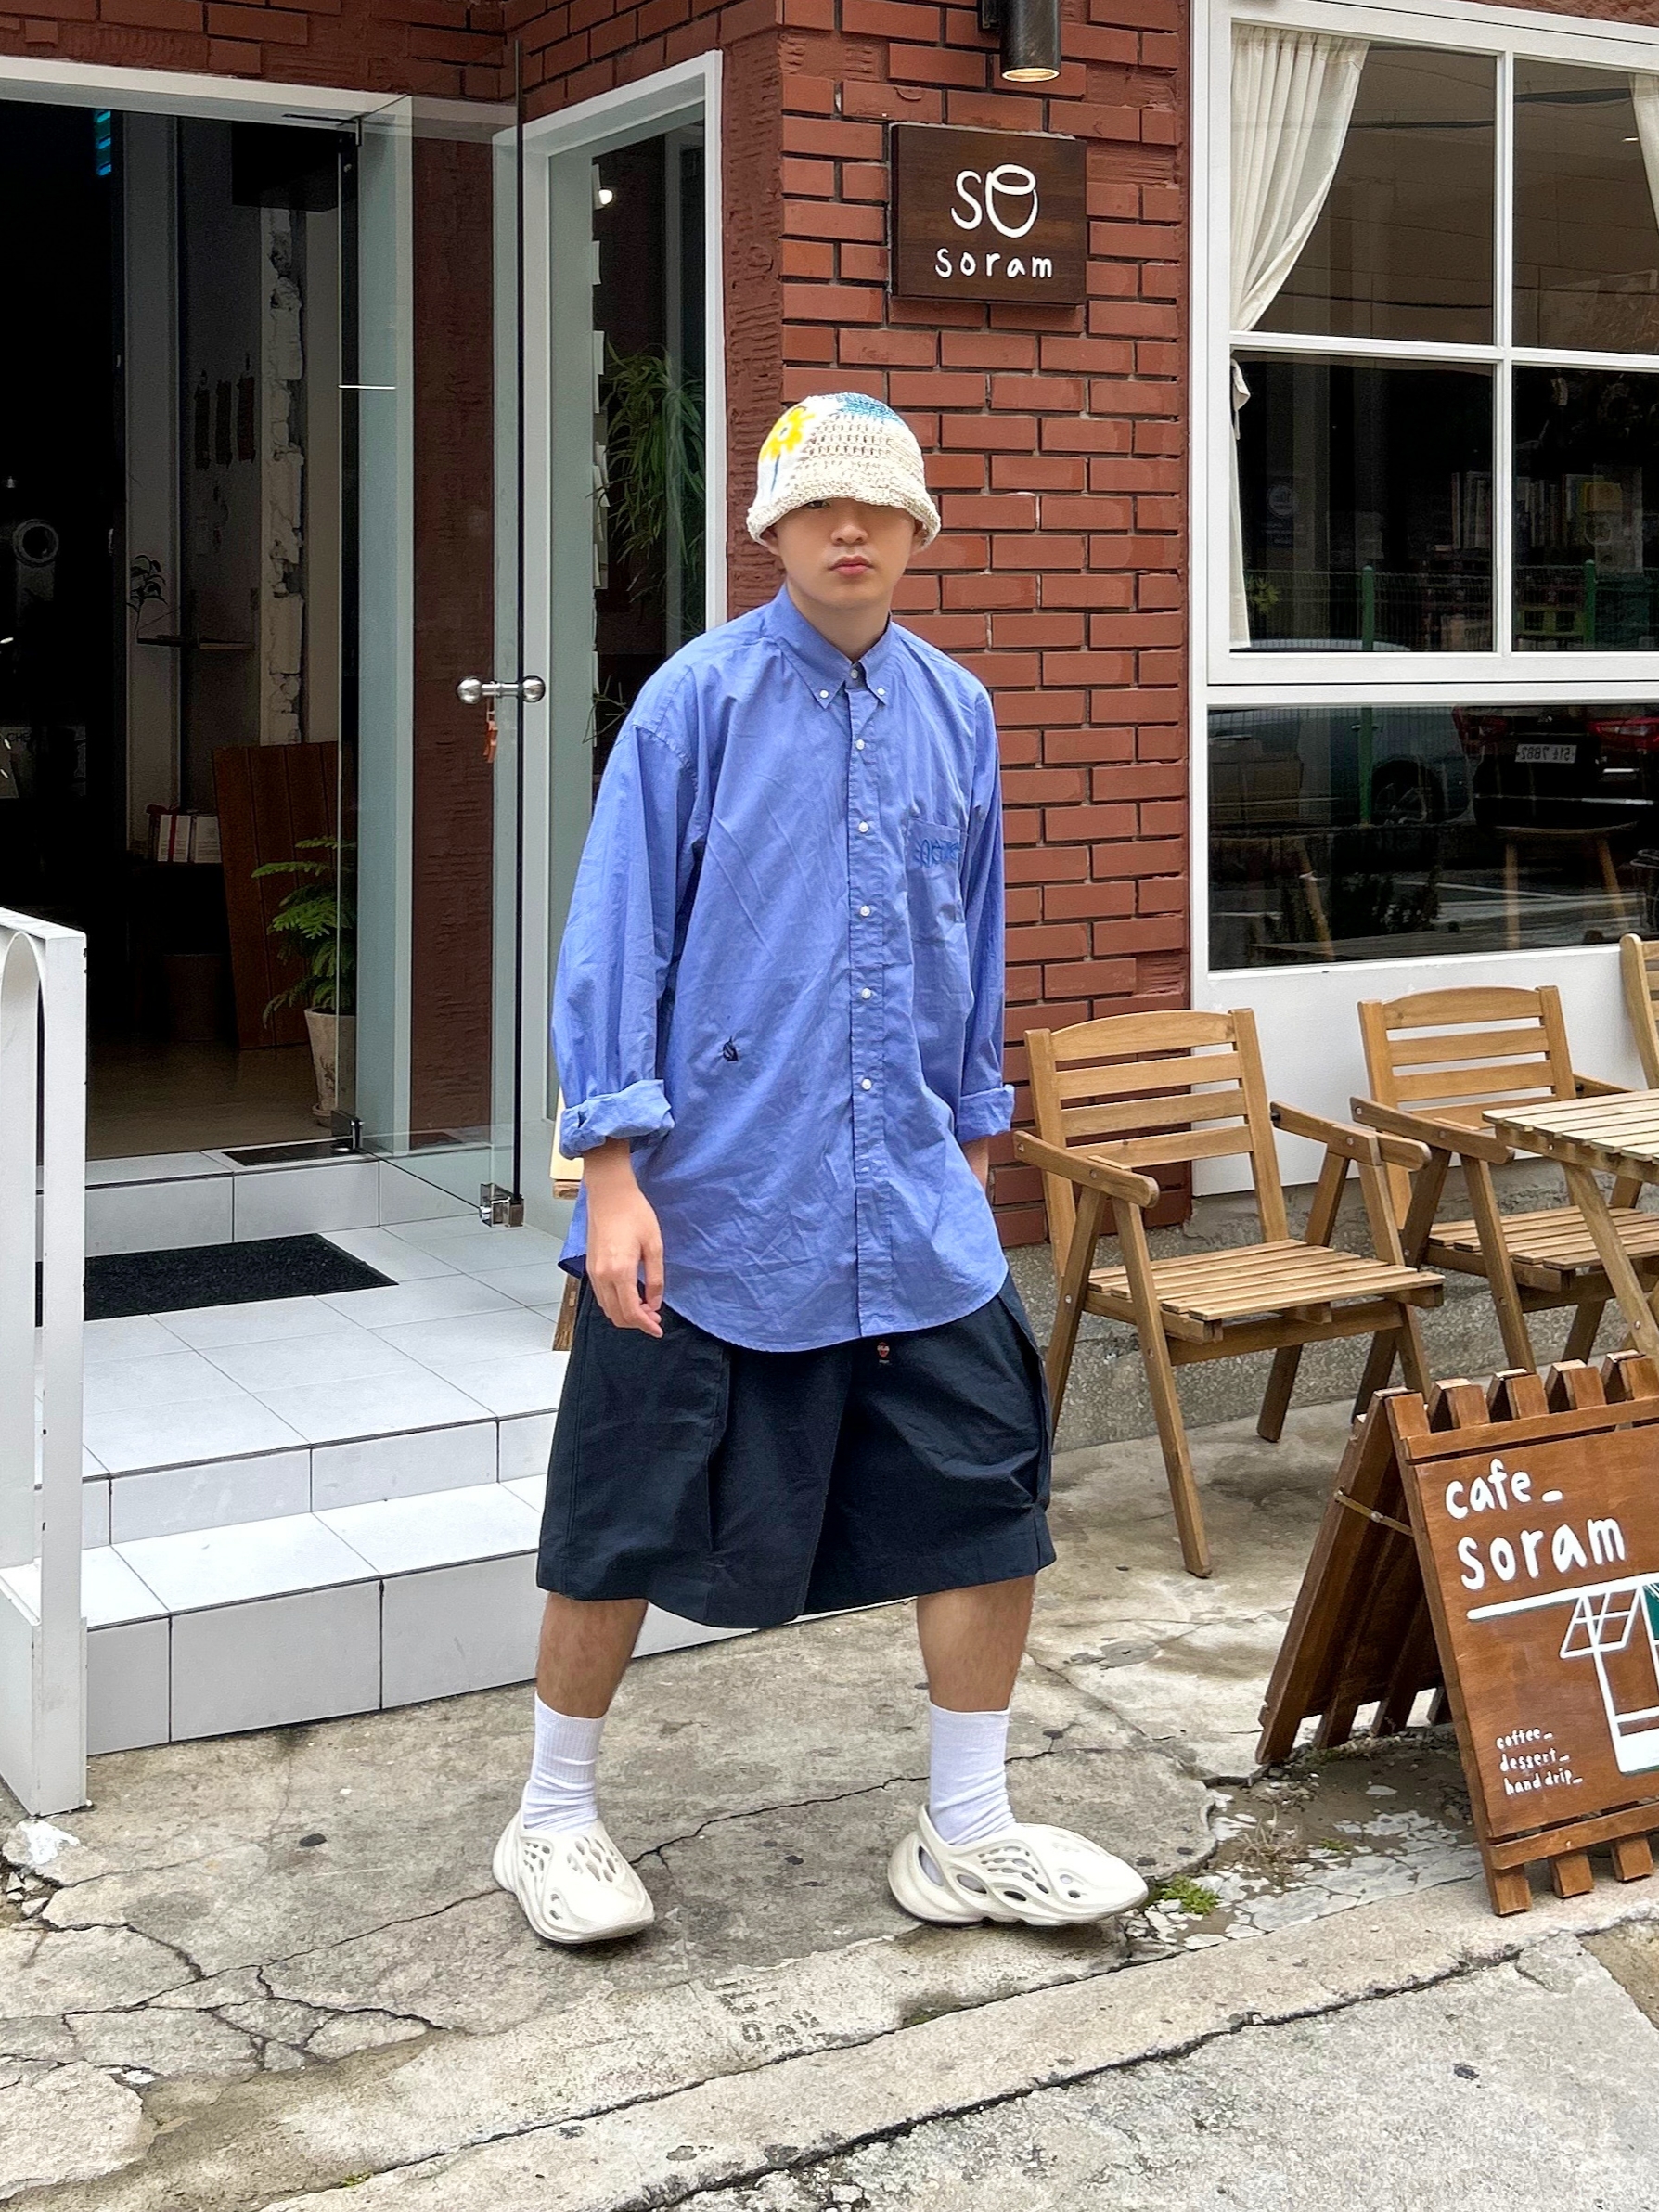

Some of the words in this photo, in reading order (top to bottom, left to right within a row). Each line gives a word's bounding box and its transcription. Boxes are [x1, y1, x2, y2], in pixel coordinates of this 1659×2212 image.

[935, 247, 1053, 278] soram
[1457, 1517, 1626, 1590] soram
[1503, 1772, 1541, 1796] hand
